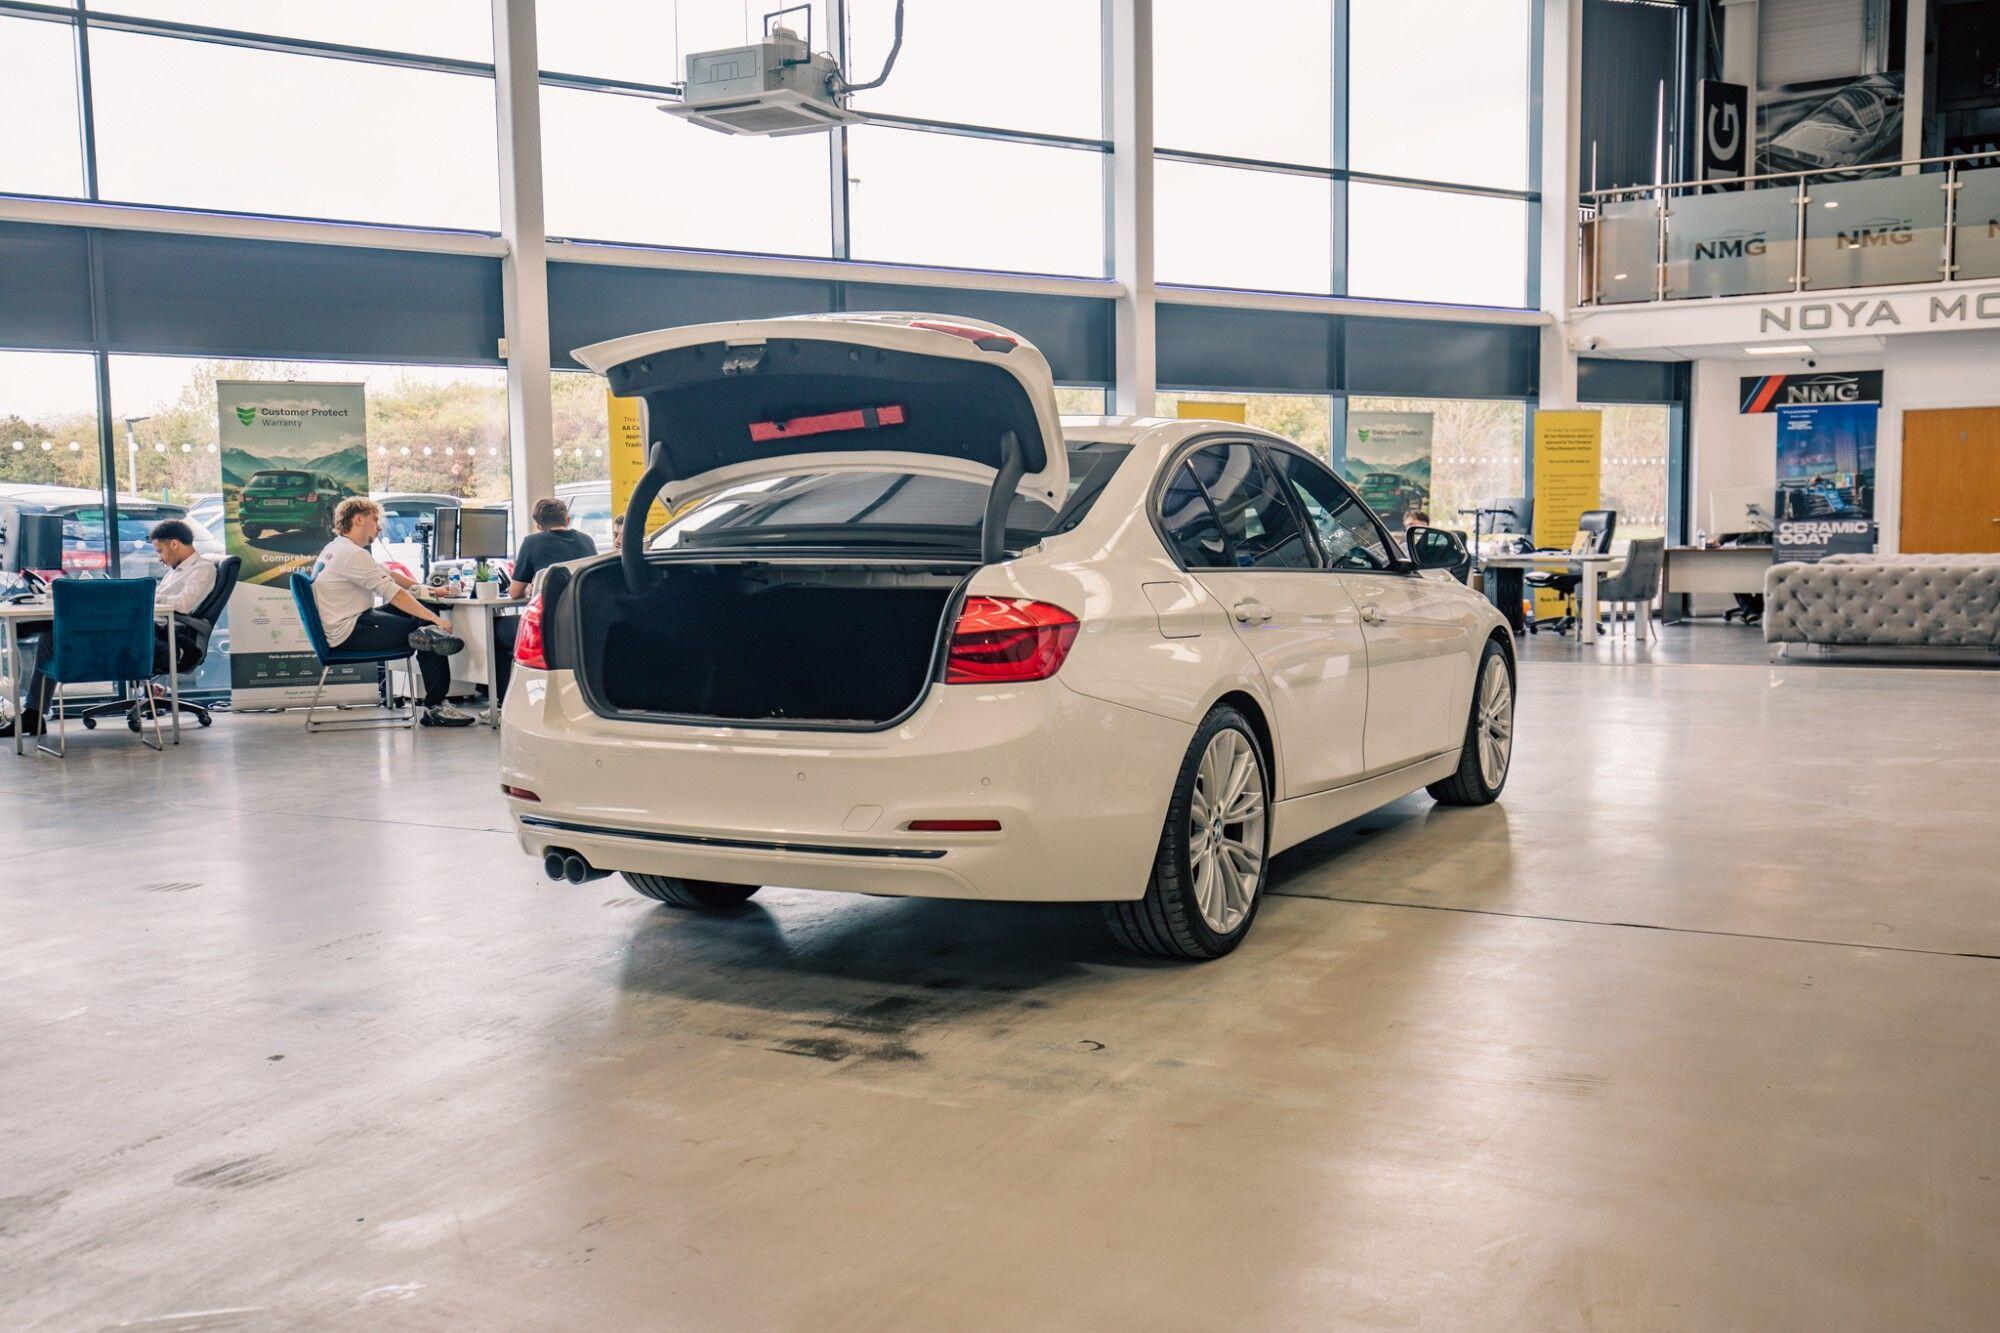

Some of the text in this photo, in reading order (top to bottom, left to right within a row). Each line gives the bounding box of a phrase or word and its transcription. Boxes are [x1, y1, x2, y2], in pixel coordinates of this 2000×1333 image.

[1836, 224, 1914, 250] NMG
[1695, 238, 1767, 260] NMG
[1760, 300, 1900, 333] NOYA
[1788, 382, 1860, 403] NMG
[261, 407, 349, 417] Customer Protect
[262, 420, 302, 428] Warranty
[1778, 522, 1868, 534] CERAMIC
[1778, 533, 1833, 545] COAT
